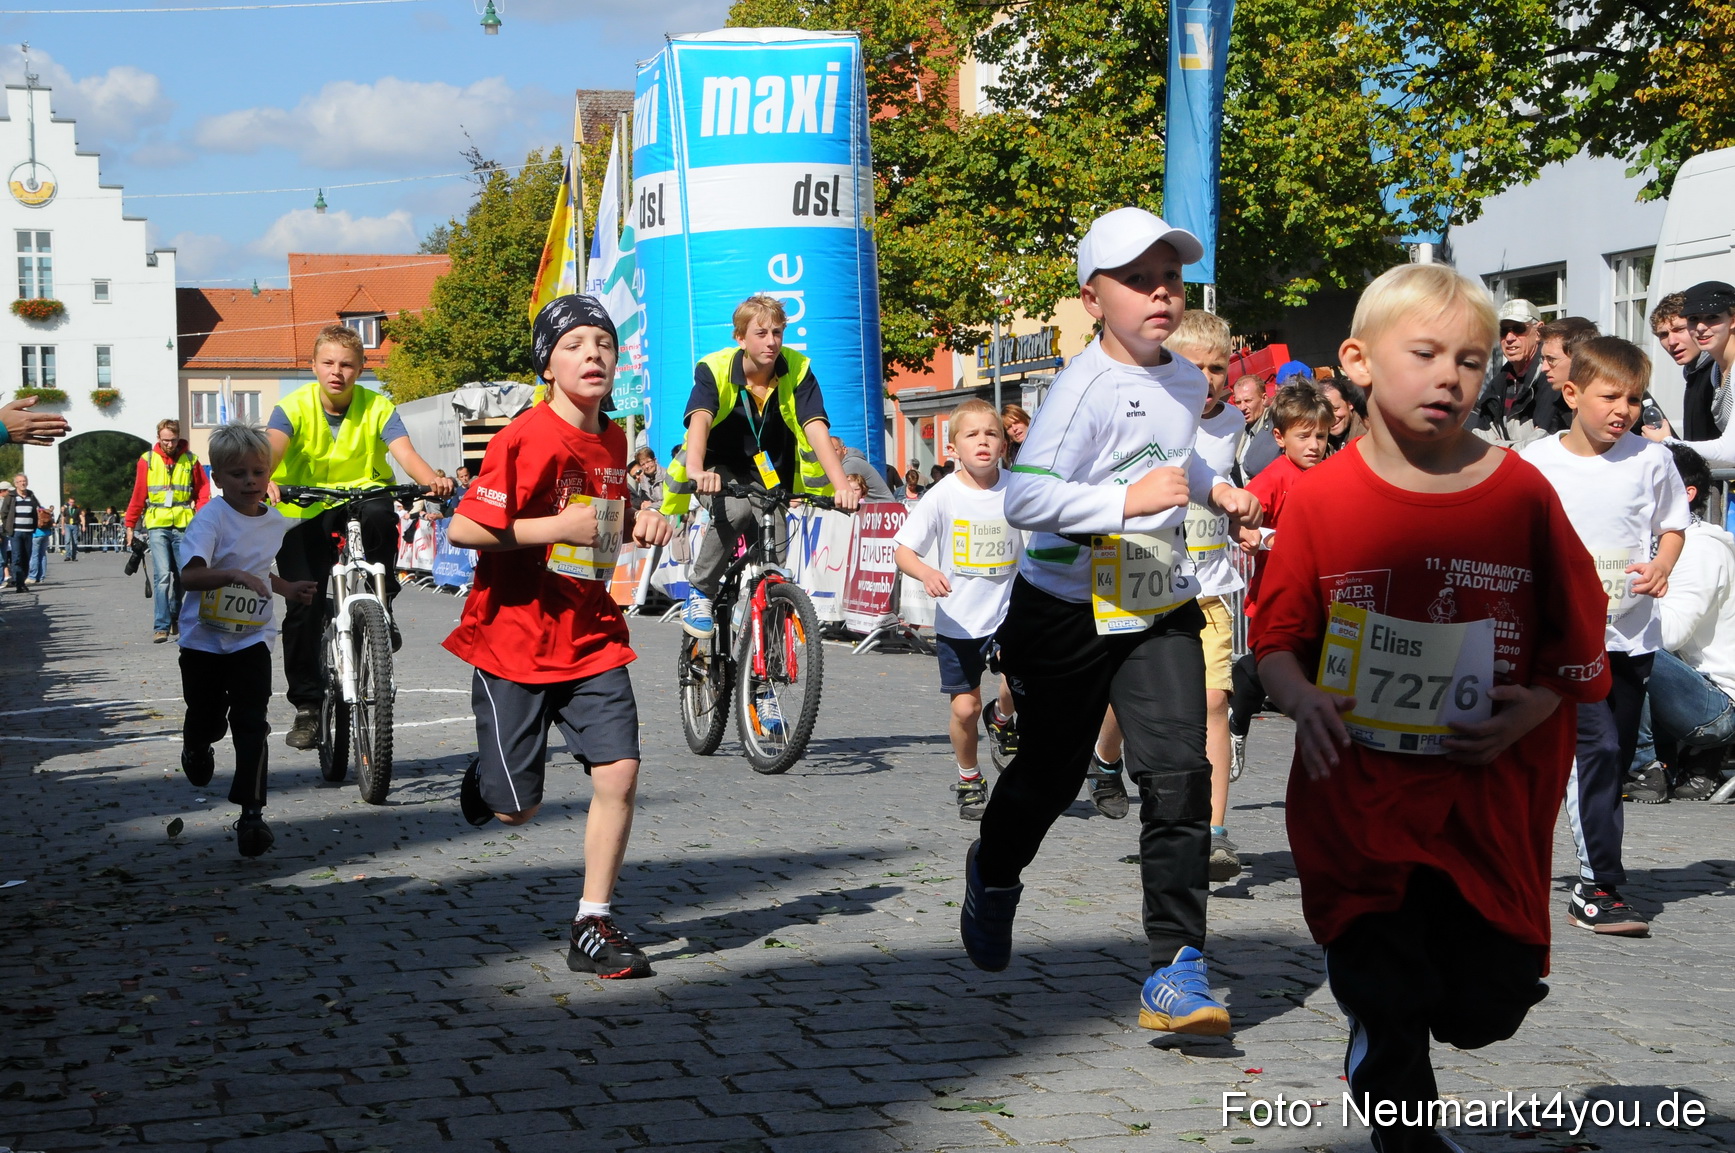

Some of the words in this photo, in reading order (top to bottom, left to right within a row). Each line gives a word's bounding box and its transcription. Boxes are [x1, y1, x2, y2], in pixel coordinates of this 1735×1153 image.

[700, 61, 840, 138] maxi
[639, 183, 665, 229] dsl
[792, 173, 840, 217] dsl
[1126, 410, 1146, 418] erima
[595, 504, 619, 522] ukas
[972, 524, 1001, 536] Tobias
[1184, 516, 1225, 539] 7093
[973, 538, 1013, 558] 7281
[1126, 541, 1160, 561] Leon
[1097, 572, 1113, 587] K4
[1128, 564, 1190, 599] 7013
[1425, 557, 1446, 571] 11.
[1450, 558, 1533, 583] NEUMARKTE
[1444, 572, 1520, 593] STADTLAUF
[224, 594, 268, 616] 7007
[1370, 623, 1423, 658] Elias
[1326, 654, 1347, 677] K4
[1369, 667, 1480, 711] 7276
